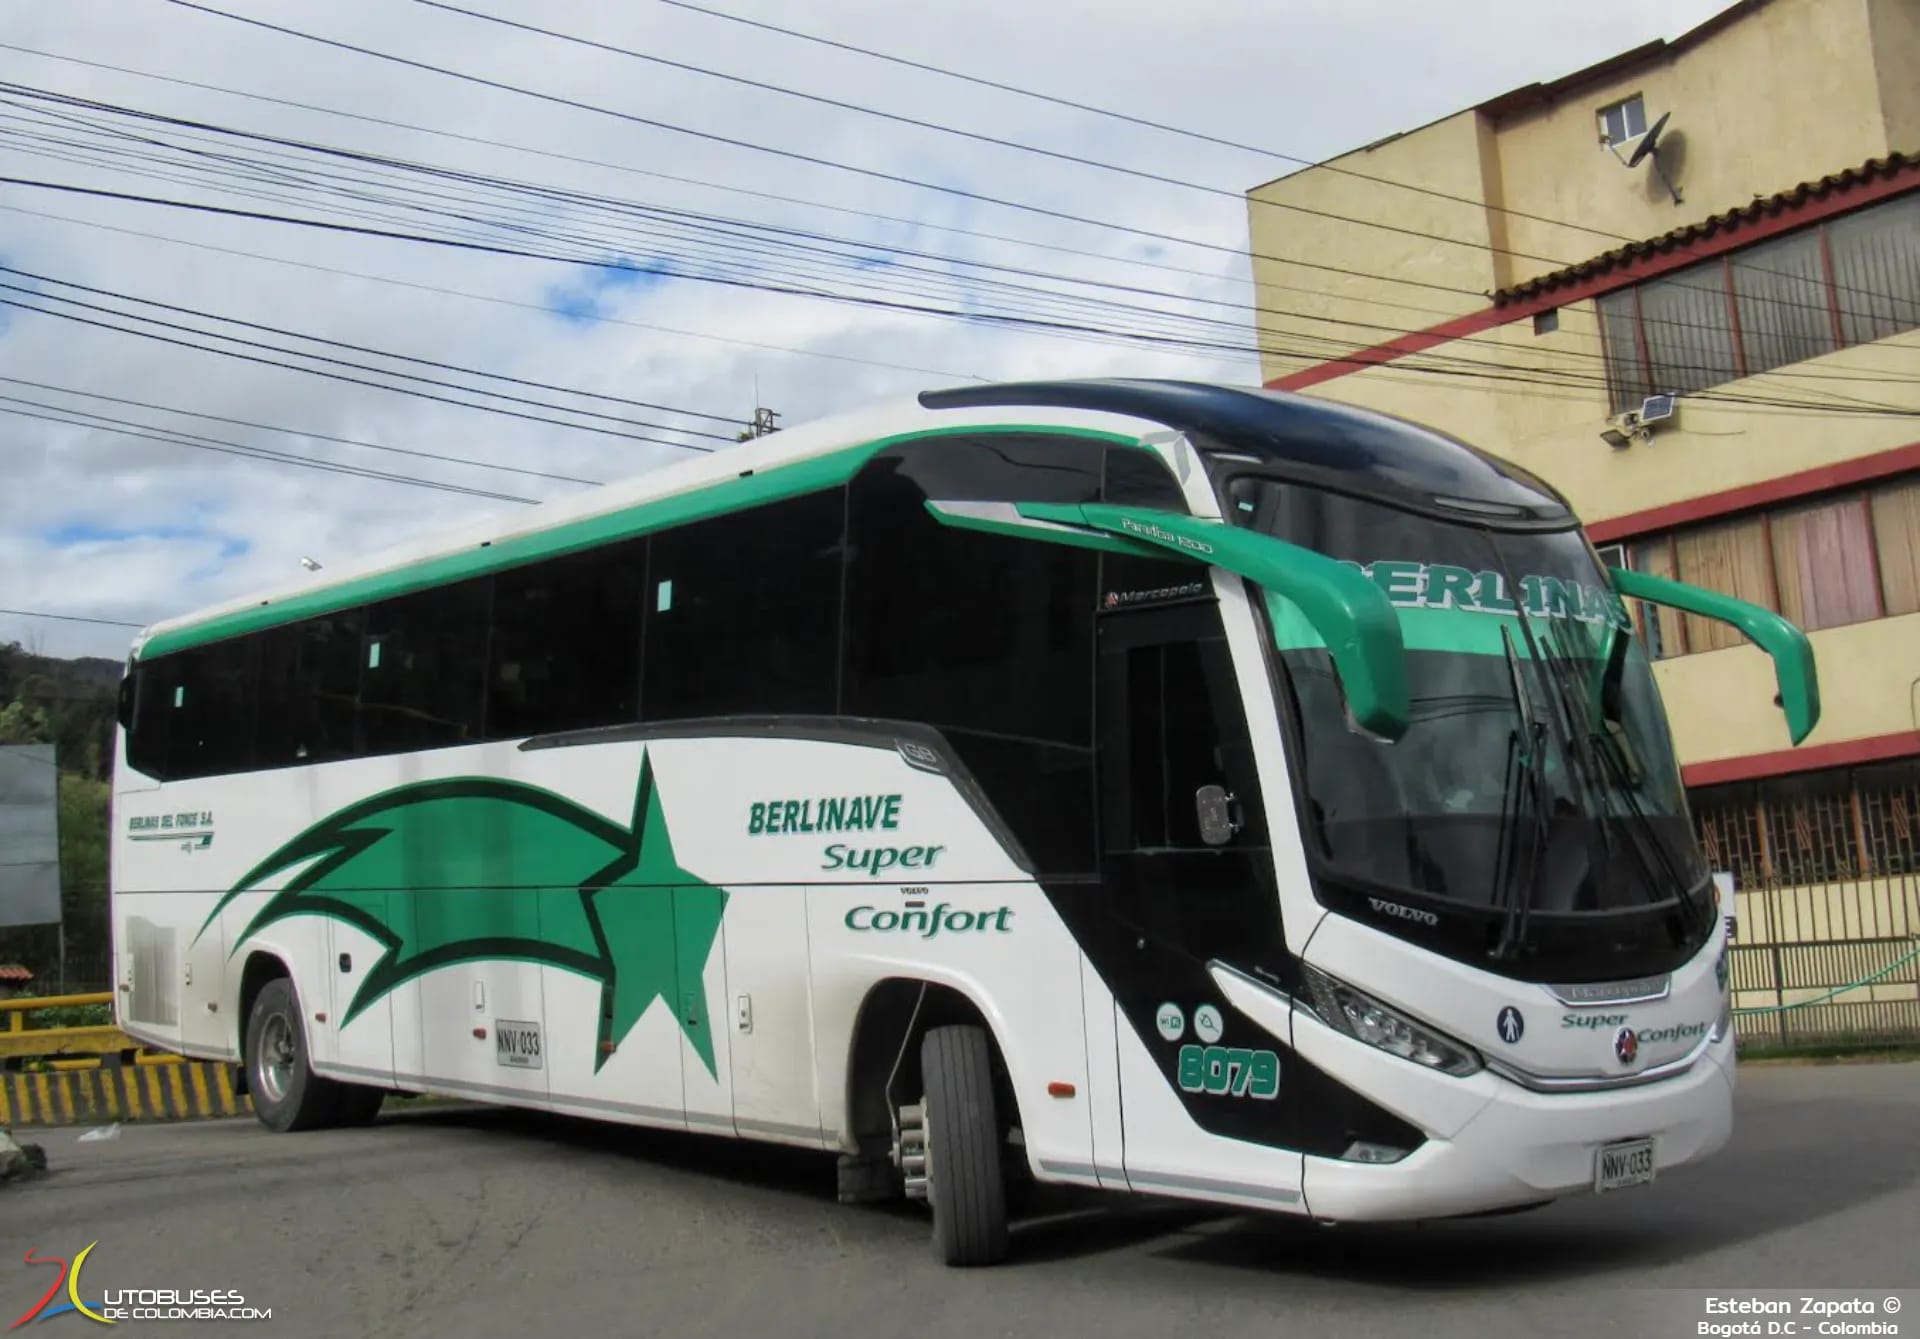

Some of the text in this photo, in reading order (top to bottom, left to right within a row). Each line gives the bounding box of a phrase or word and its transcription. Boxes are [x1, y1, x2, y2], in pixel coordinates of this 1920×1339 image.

[1121, 518, 1213, 554] Paradiso 1200
[1119, 583, 1203, 602] Marcopolo
[748, 794, 903, 836] BERLINAVE
[821, 844, 946, 876] Super
[844, 903, 1015, 940] Confort
[1368, 896, 1439, 926] VOLVO
[1560, 1013, 1629, 1029] Super
[1637, 1022, 1706, 1043] Confort
[520, 1031, 539, 1055] 033
[1178, 1044, 1280, 1100] 8079
[1629, 1148, 1651, 1175] 033
